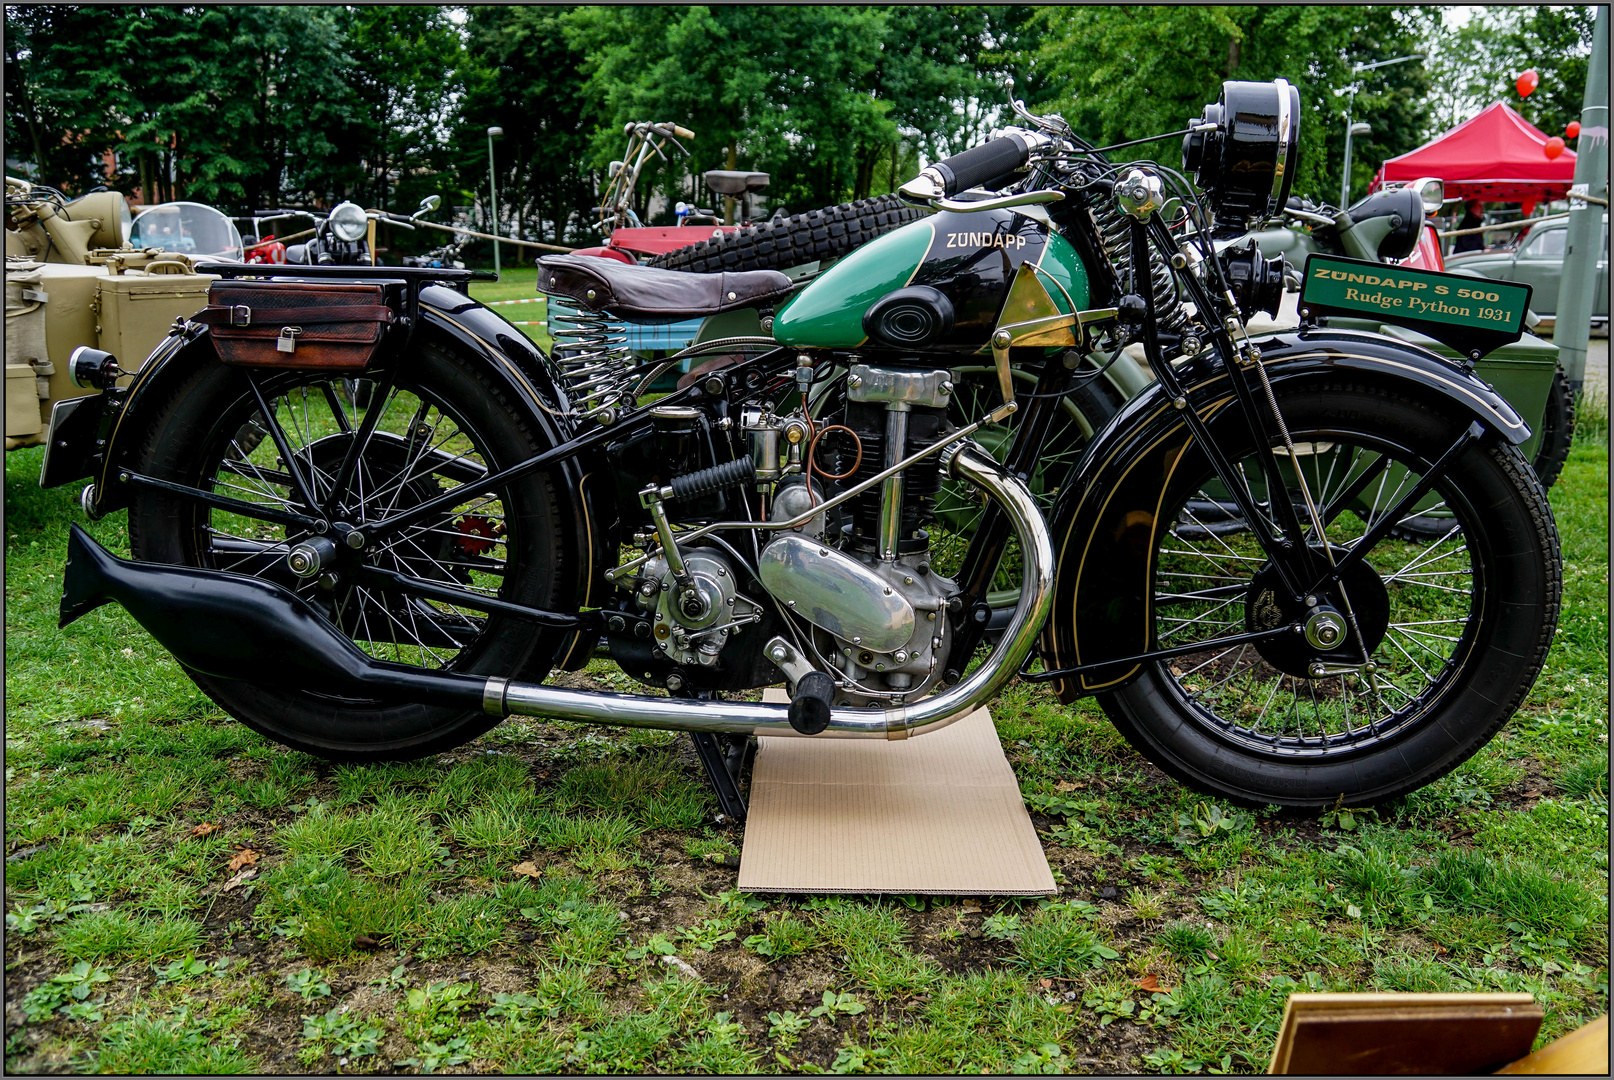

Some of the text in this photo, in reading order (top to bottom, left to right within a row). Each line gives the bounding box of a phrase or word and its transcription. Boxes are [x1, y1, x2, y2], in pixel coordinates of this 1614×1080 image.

[946, 232, 1026, 250] ZÜNDAPP
[1314, 269, 1500, 303] ZÜNDAPP S 500
[1345, 287, 1512, 323] Rudge Python 1931
